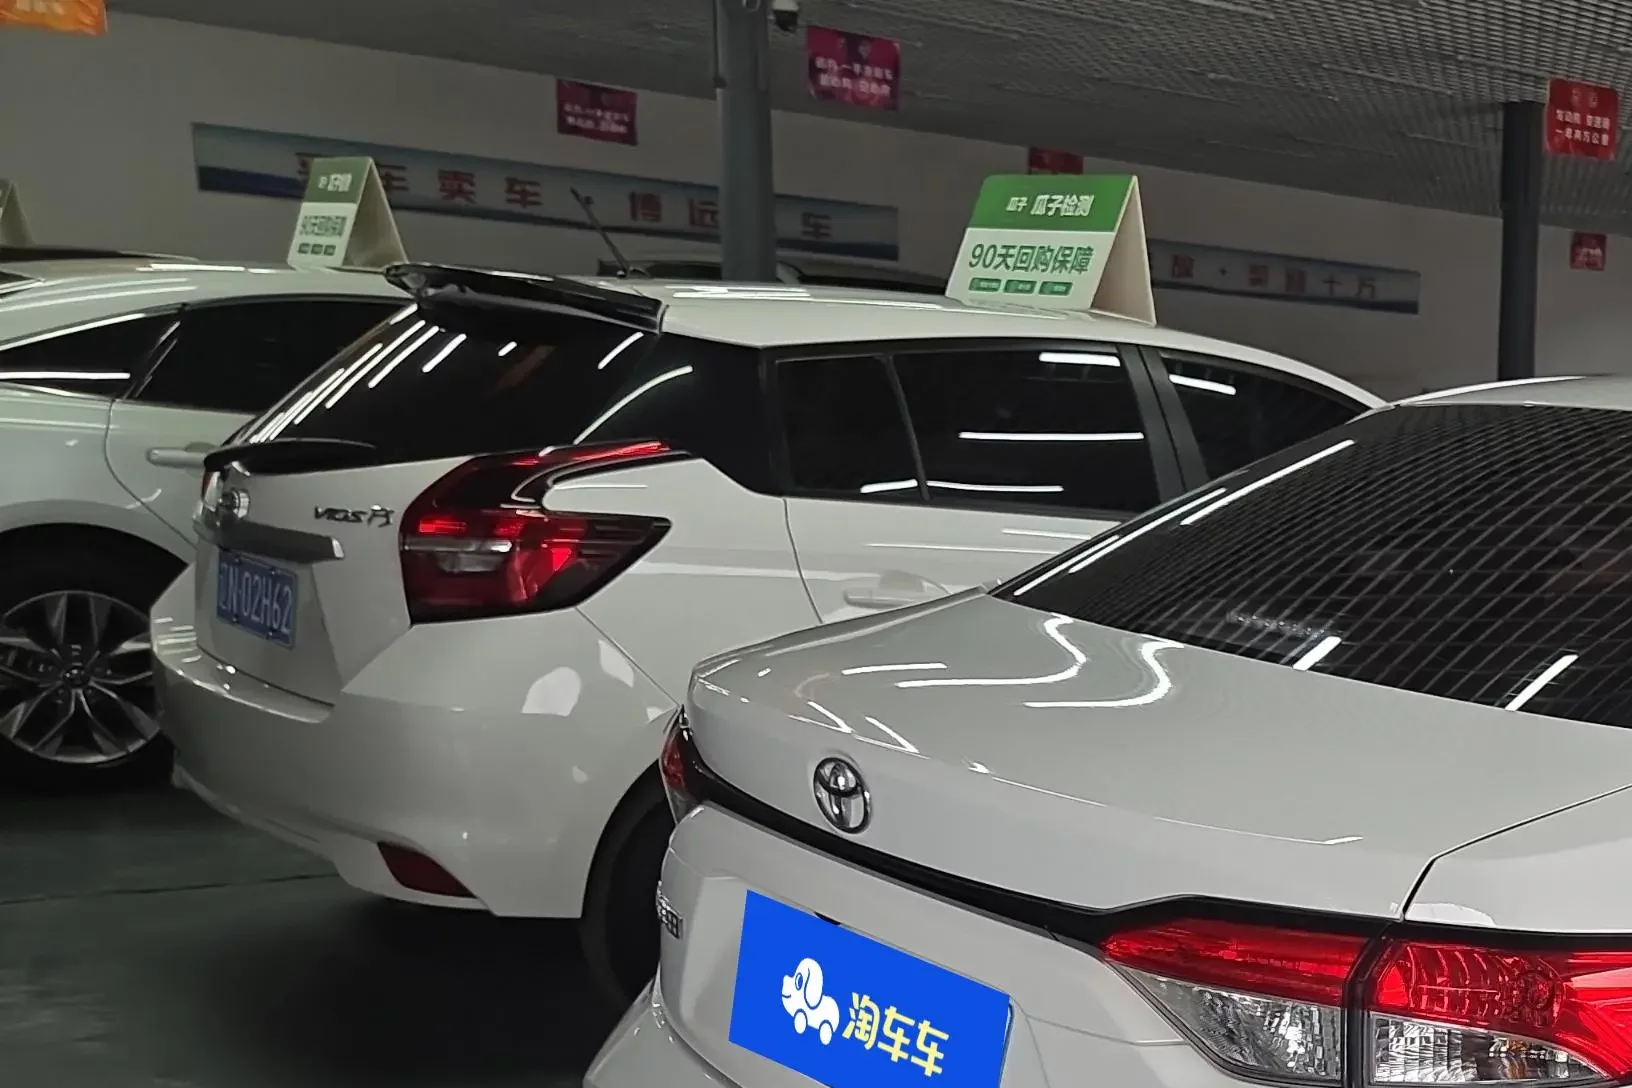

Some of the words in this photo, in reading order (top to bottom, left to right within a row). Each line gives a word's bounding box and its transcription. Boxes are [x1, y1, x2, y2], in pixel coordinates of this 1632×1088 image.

[1030, 194, 1095, 217] 瓜子检测
[968, 243, 1094, 275] 90天回购保障
